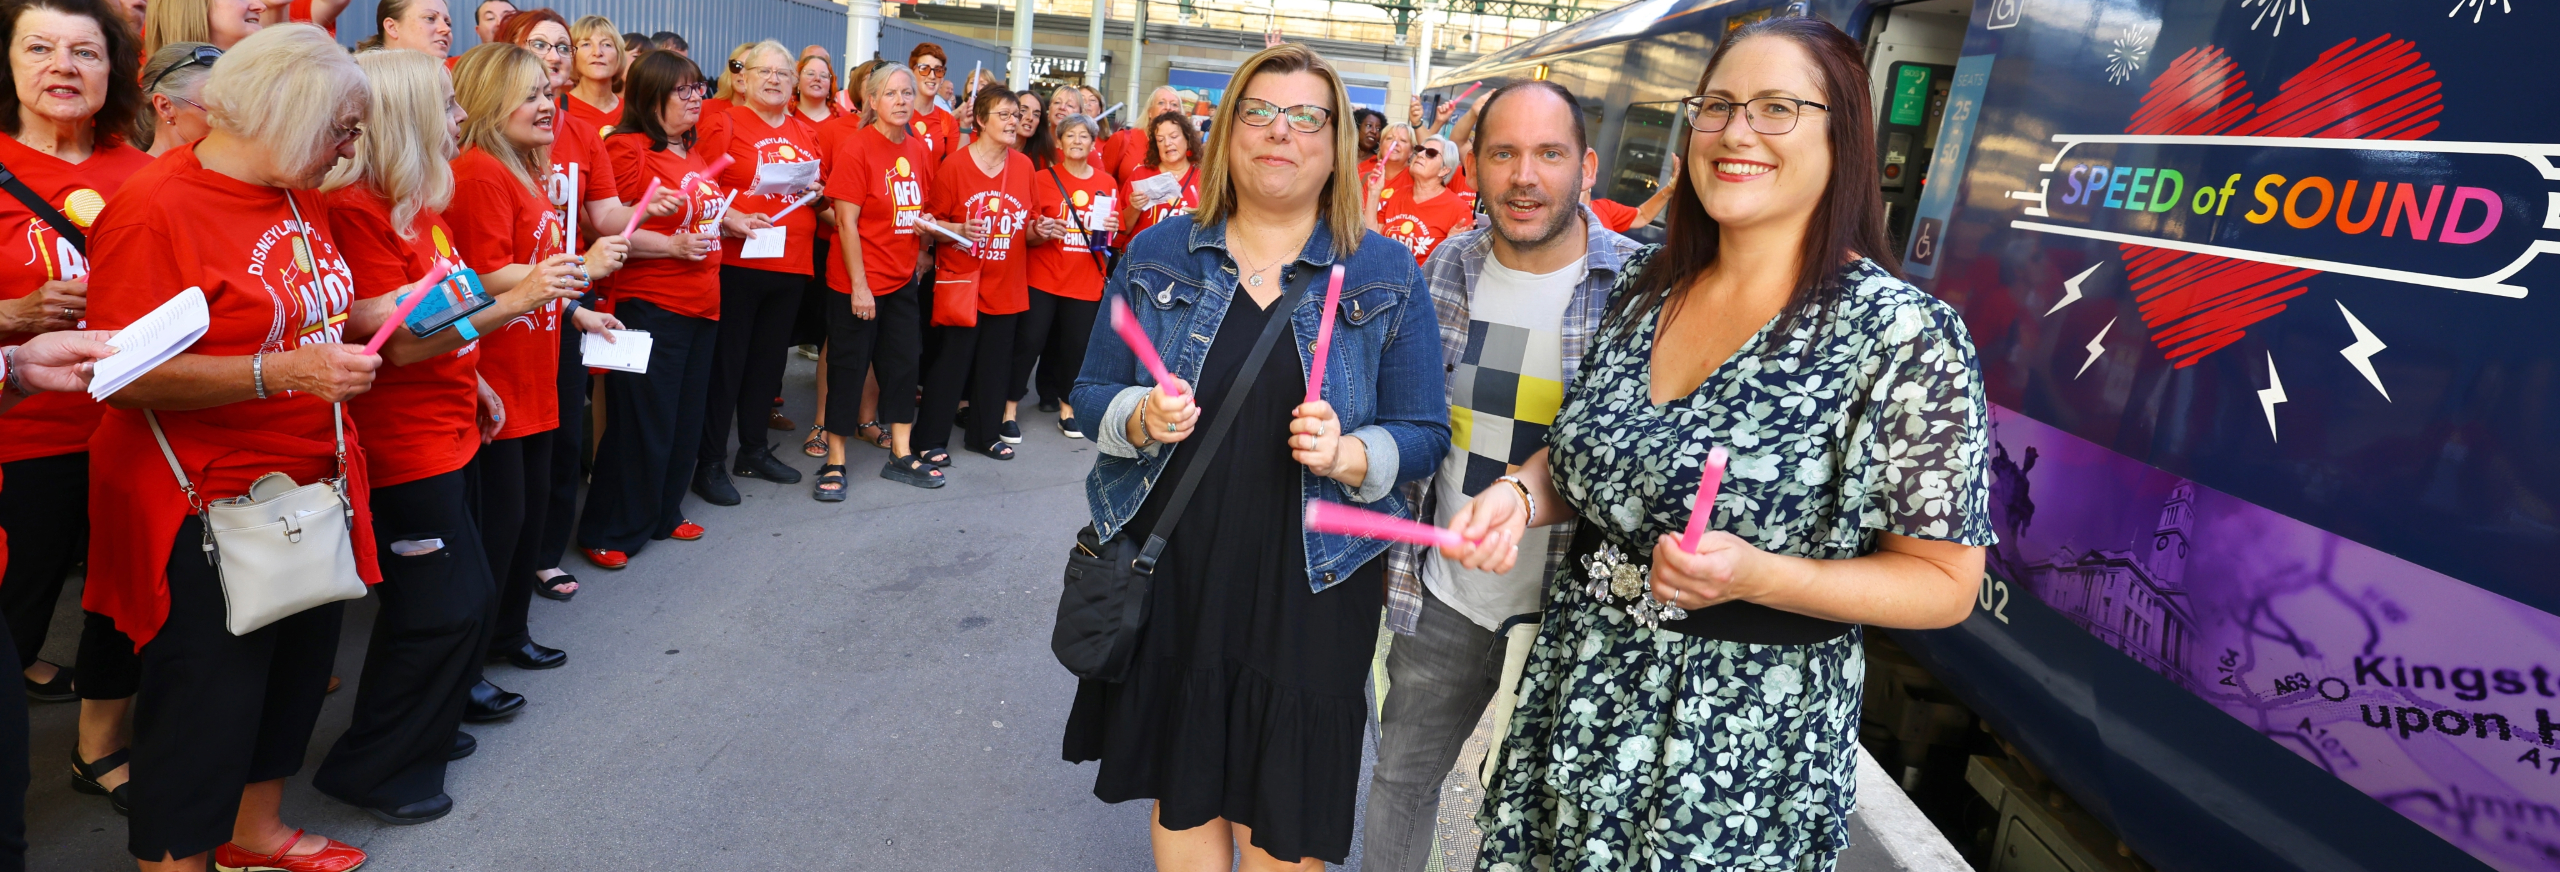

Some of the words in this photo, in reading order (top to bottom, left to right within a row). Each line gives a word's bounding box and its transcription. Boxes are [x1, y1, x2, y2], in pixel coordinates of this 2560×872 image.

[1903, 69, 1920, 77] SOS
[1957, 73, 1985, 87] SEATS
[1952, 101, 1972, 121] 25
[1940, 143, 1960, 163] 50
[894, 181, 921, 206] AFO
[965, 190, 1002, 208] DISNEYLAN
[1004, 193, 1022, 209] PARIS
[2061, 164, 2184, 213] SPEED
[2192, 173, 2242, 216] of
[2244, 174, 2503, 244] SOUND
[1066, 208, 1092, 230] AFO
[1386, 214, 1420, 223] DISNEYLAND
[248, 219, 301, 276] DISNEYLAN
[1064, 232, 1092, 247] CHO
[978, 249, 1006, 260] 2025
[1979, 571, 2009, 625] 02
[2218, 648, 2240, 687] A164
[2274, 672, 2311, 696] A63
[2354, 656, 2560, 702] Kingst
[2360, 704, 2512, 742] upon
